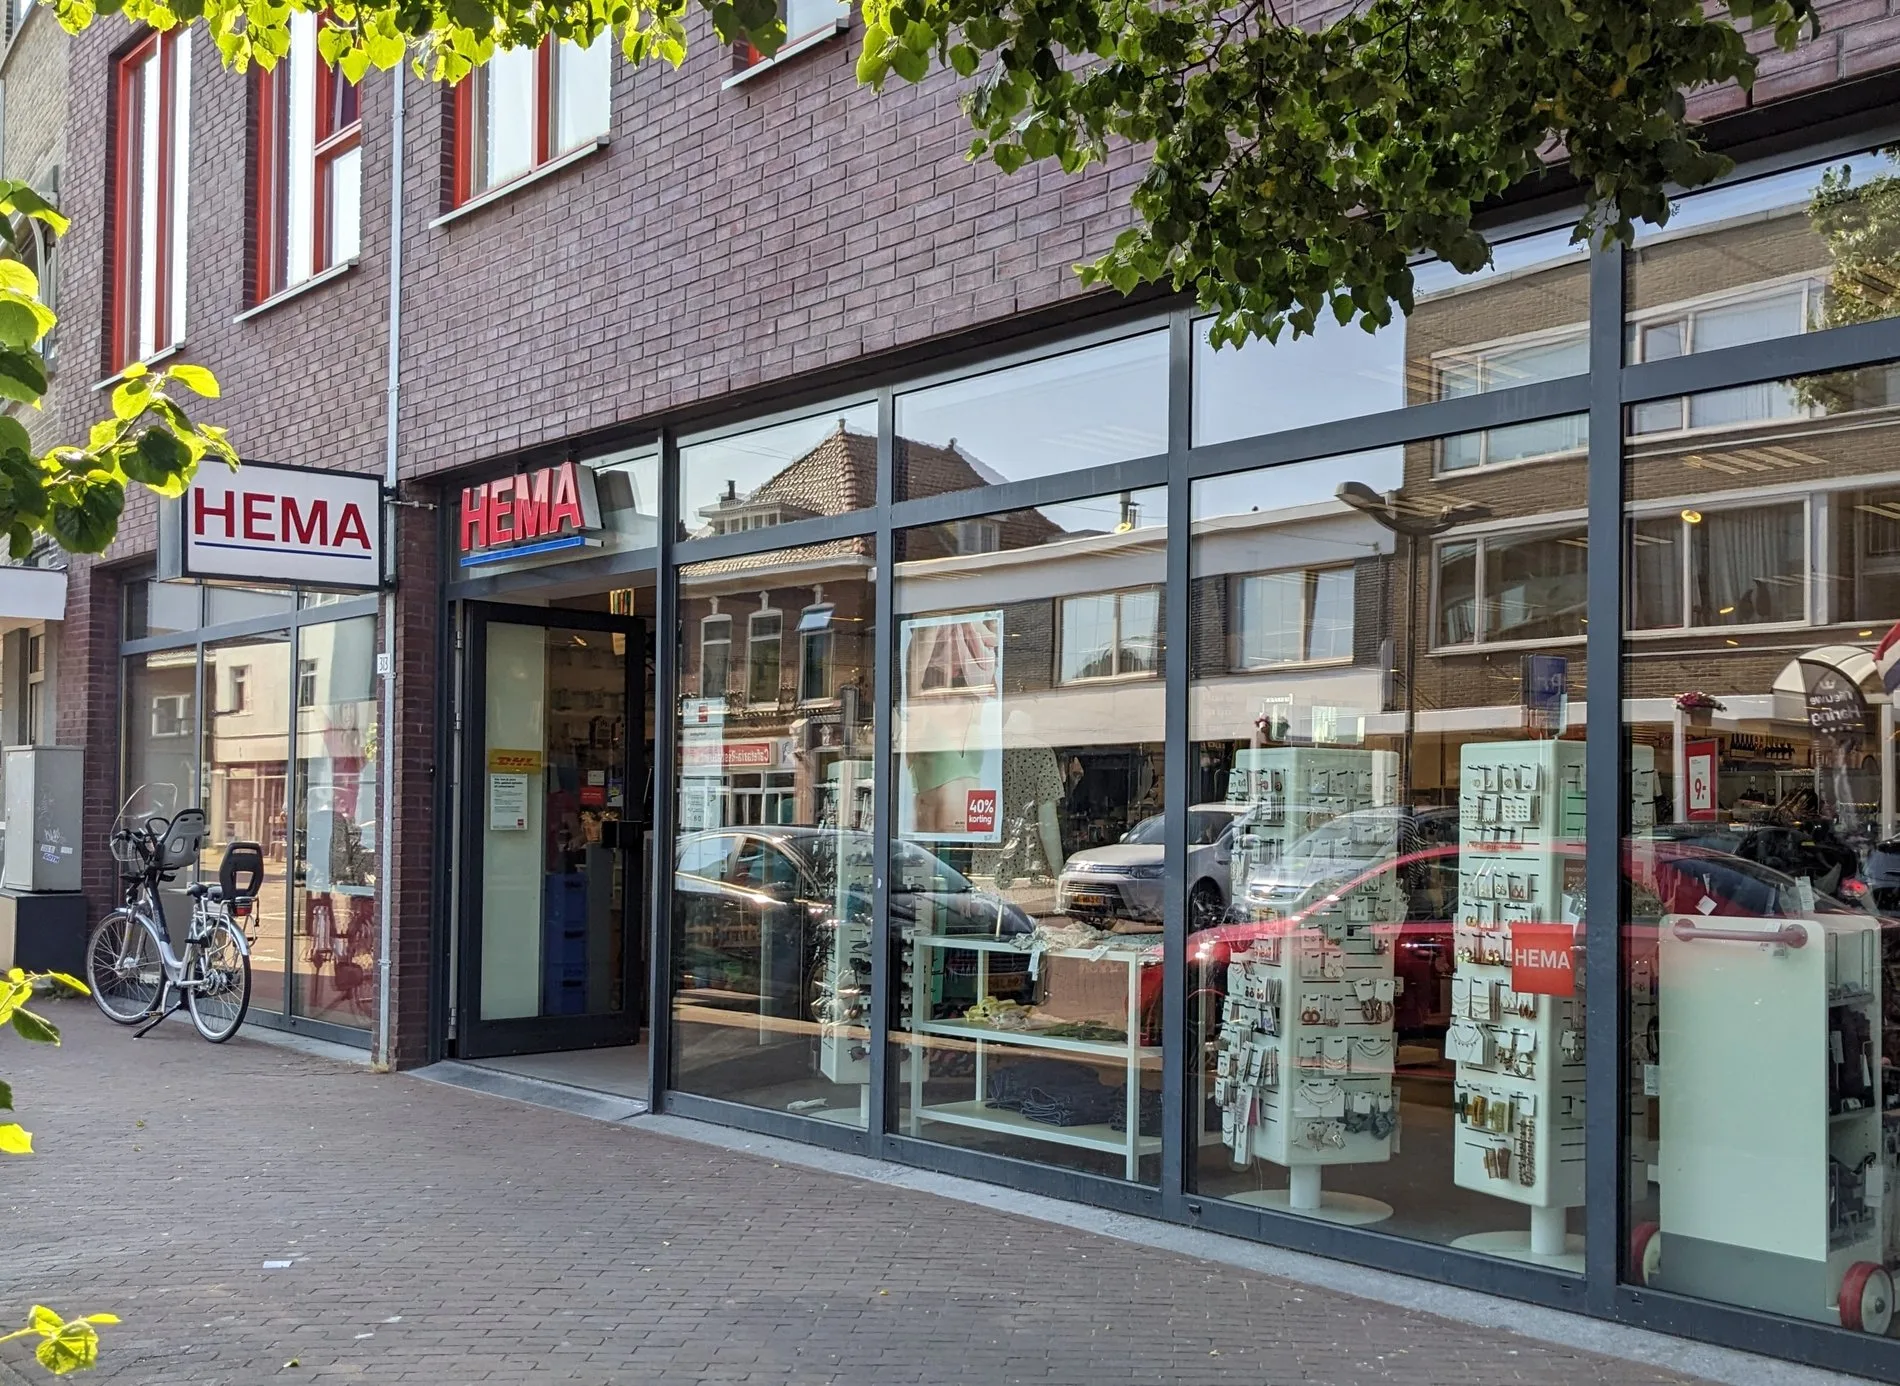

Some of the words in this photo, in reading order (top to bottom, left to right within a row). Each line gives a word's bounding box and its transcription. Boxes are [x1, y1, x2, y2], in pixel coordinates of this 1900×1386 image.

[461, 461, 583, 551] HEMA
[194, 487, 372, 549] HEMA
[496, 756, 534, 767] DHL
[969, 799, 994, 813] 40%
[968, 815, 992, 825] korting
[1514, 947, 1571, 970] HEMA
